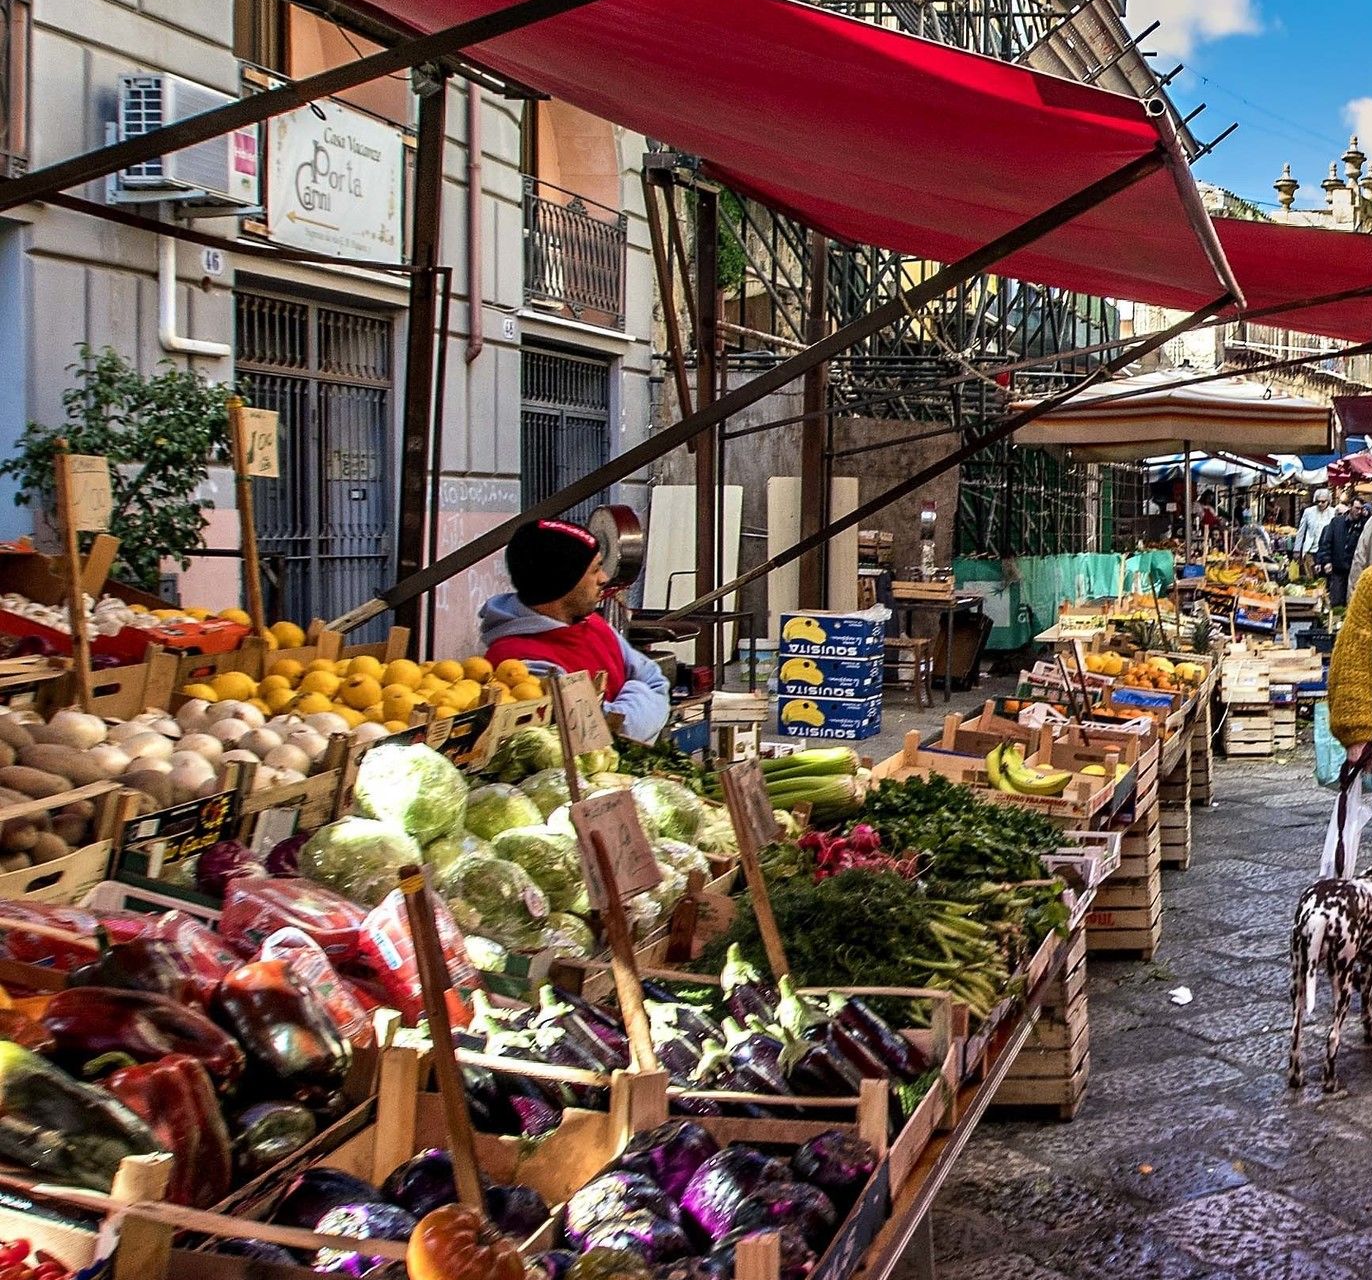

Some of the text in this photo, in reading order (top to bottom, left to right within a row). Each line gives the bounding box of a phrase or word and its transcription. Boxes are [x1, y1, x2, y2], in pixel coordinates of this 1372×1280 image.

[323, 126, 346, 149] Casa
[310, 139, 363, 199] Porta
[788, 643, 858, 657] SQUISITA
[785, 685, 855, 698] SQUISITA
[787, 726, 856, 739] SQUISITA
